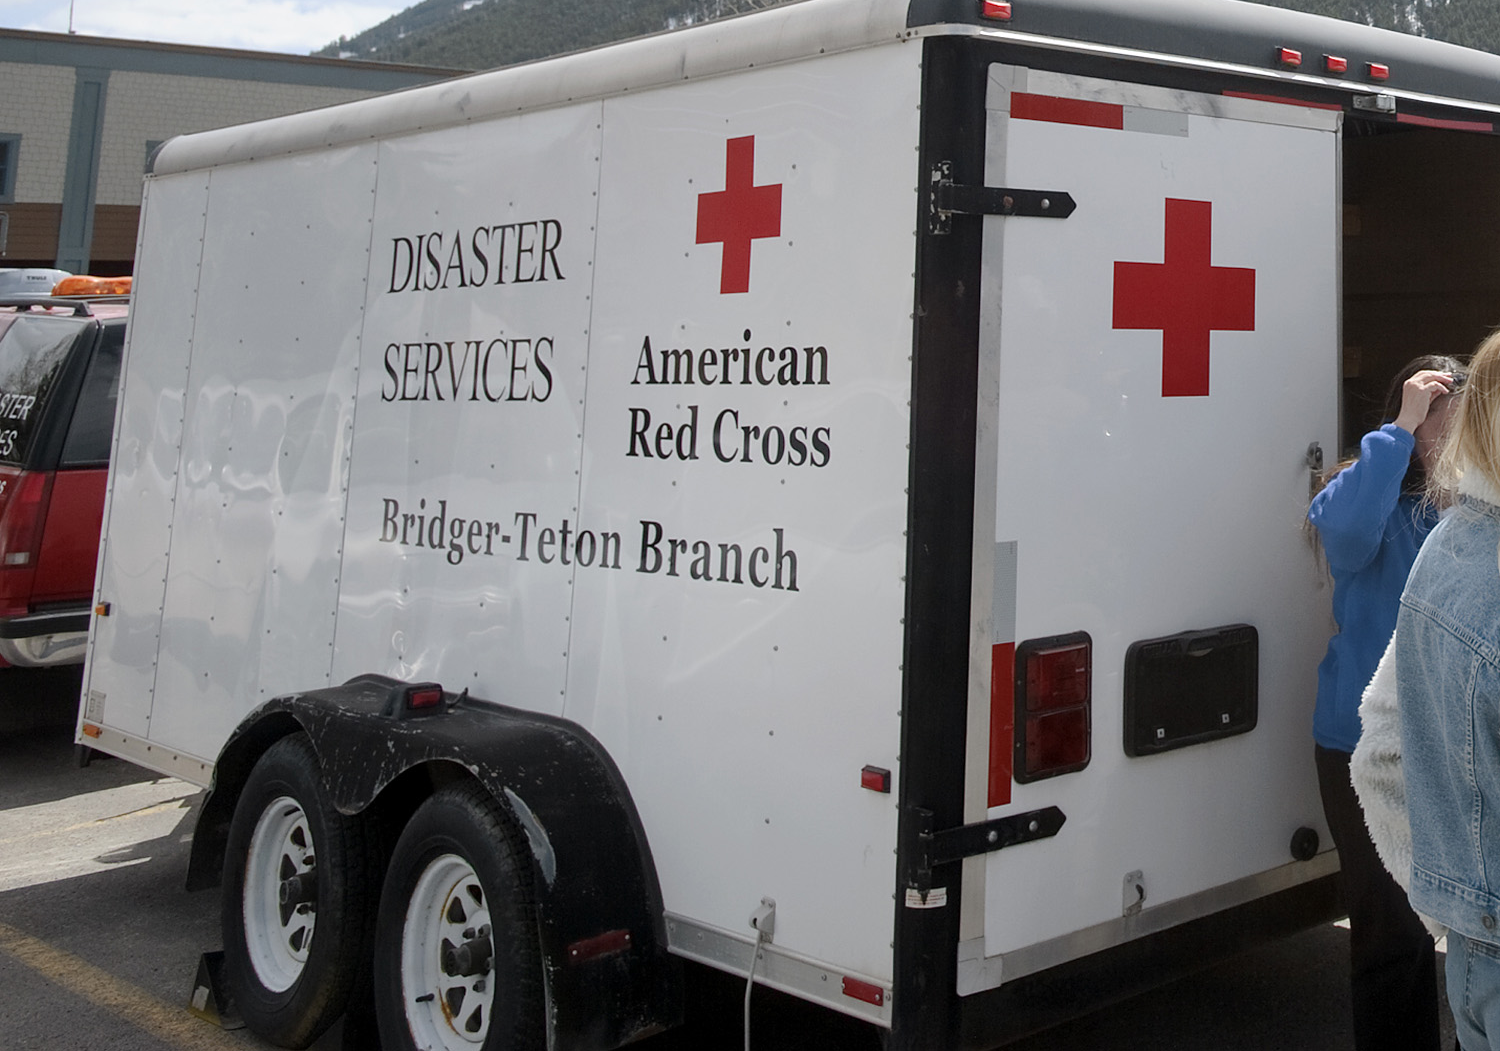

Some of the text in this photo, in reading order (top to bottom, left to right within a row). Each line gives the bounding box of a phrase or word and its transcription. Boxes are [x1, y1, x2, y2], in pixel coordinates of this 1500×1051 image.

[387, 219, 566, 294] DISASTER
[382, 336, 553, 403] SERVICES
[630, 329, 830, 386] American
[0, 393, 37, 421] STER
[626, 405, 831, 468] Red Cross
[379, 498, 800, 592] Bridger-Teton Branch
